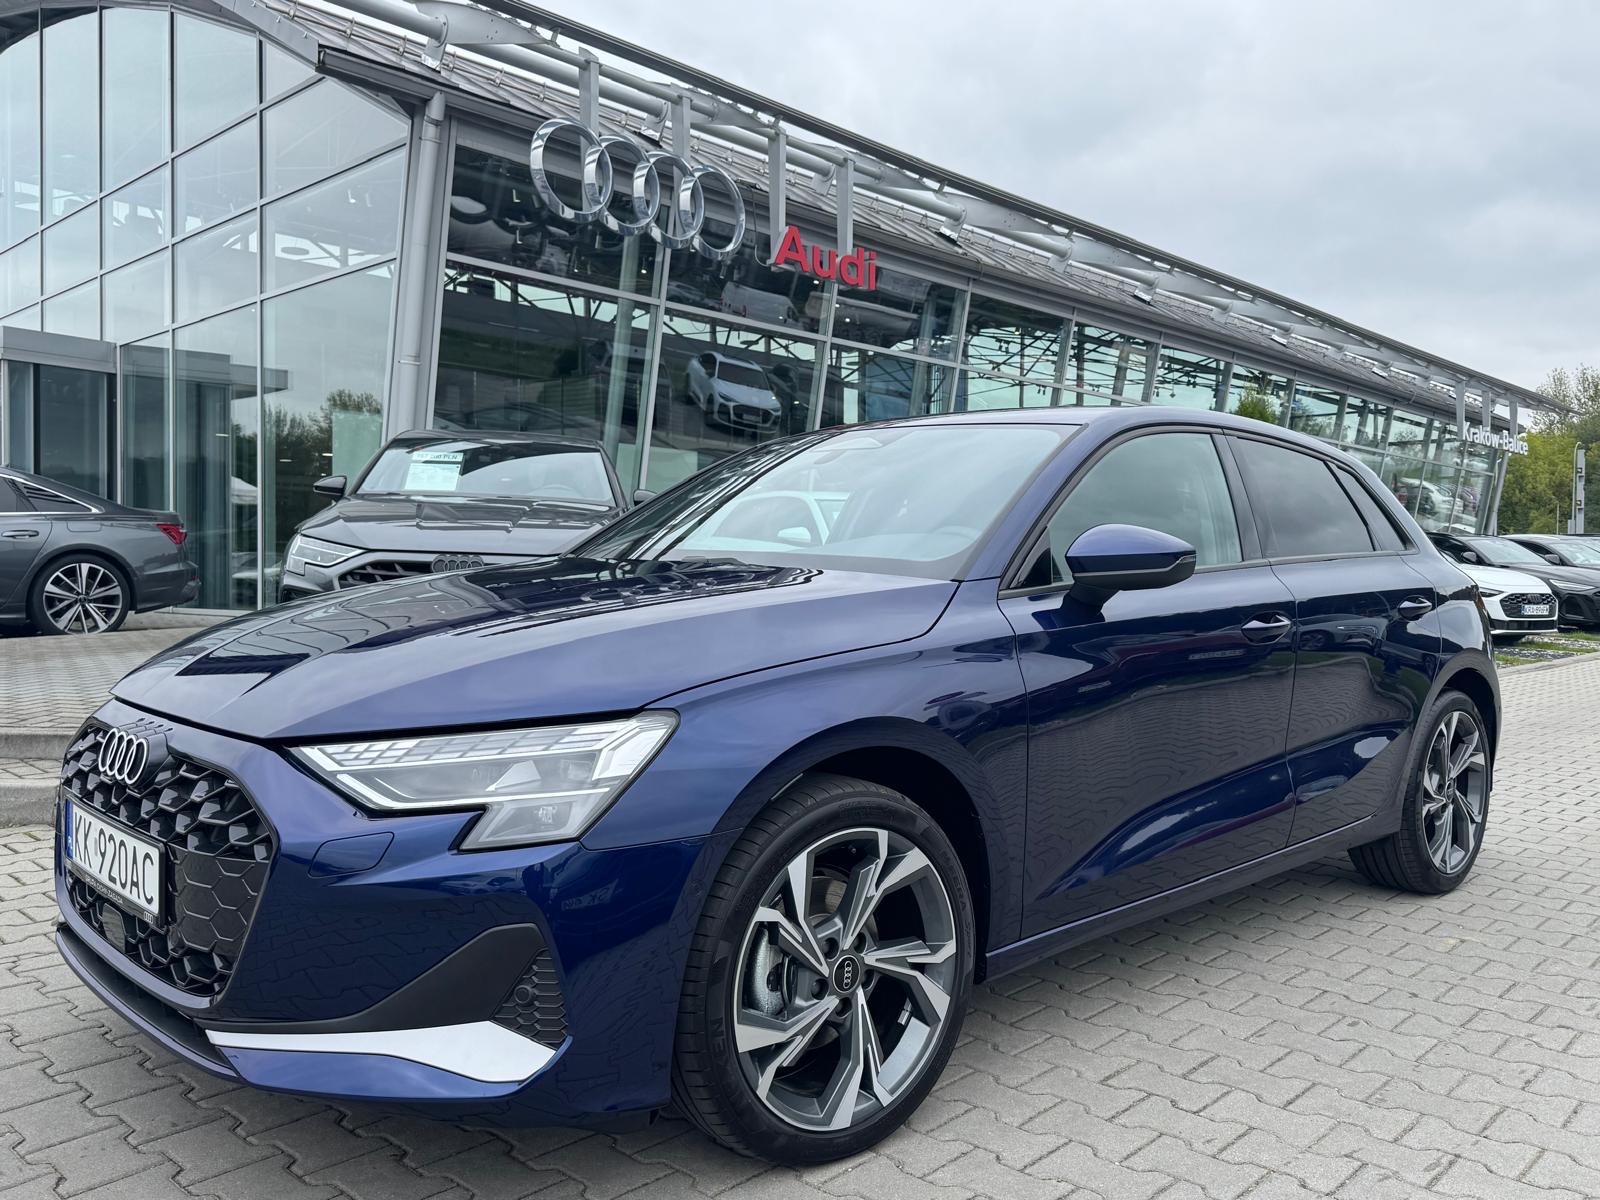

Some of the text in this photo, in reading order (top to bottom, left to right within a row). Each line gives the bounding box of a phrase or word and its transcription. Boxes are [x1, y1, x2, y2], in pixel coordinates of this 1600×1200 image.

[774, 224, 877, 291] Audi
[75, 811, 92, 869] KK
[98, 828, 154, 905] 920AC
